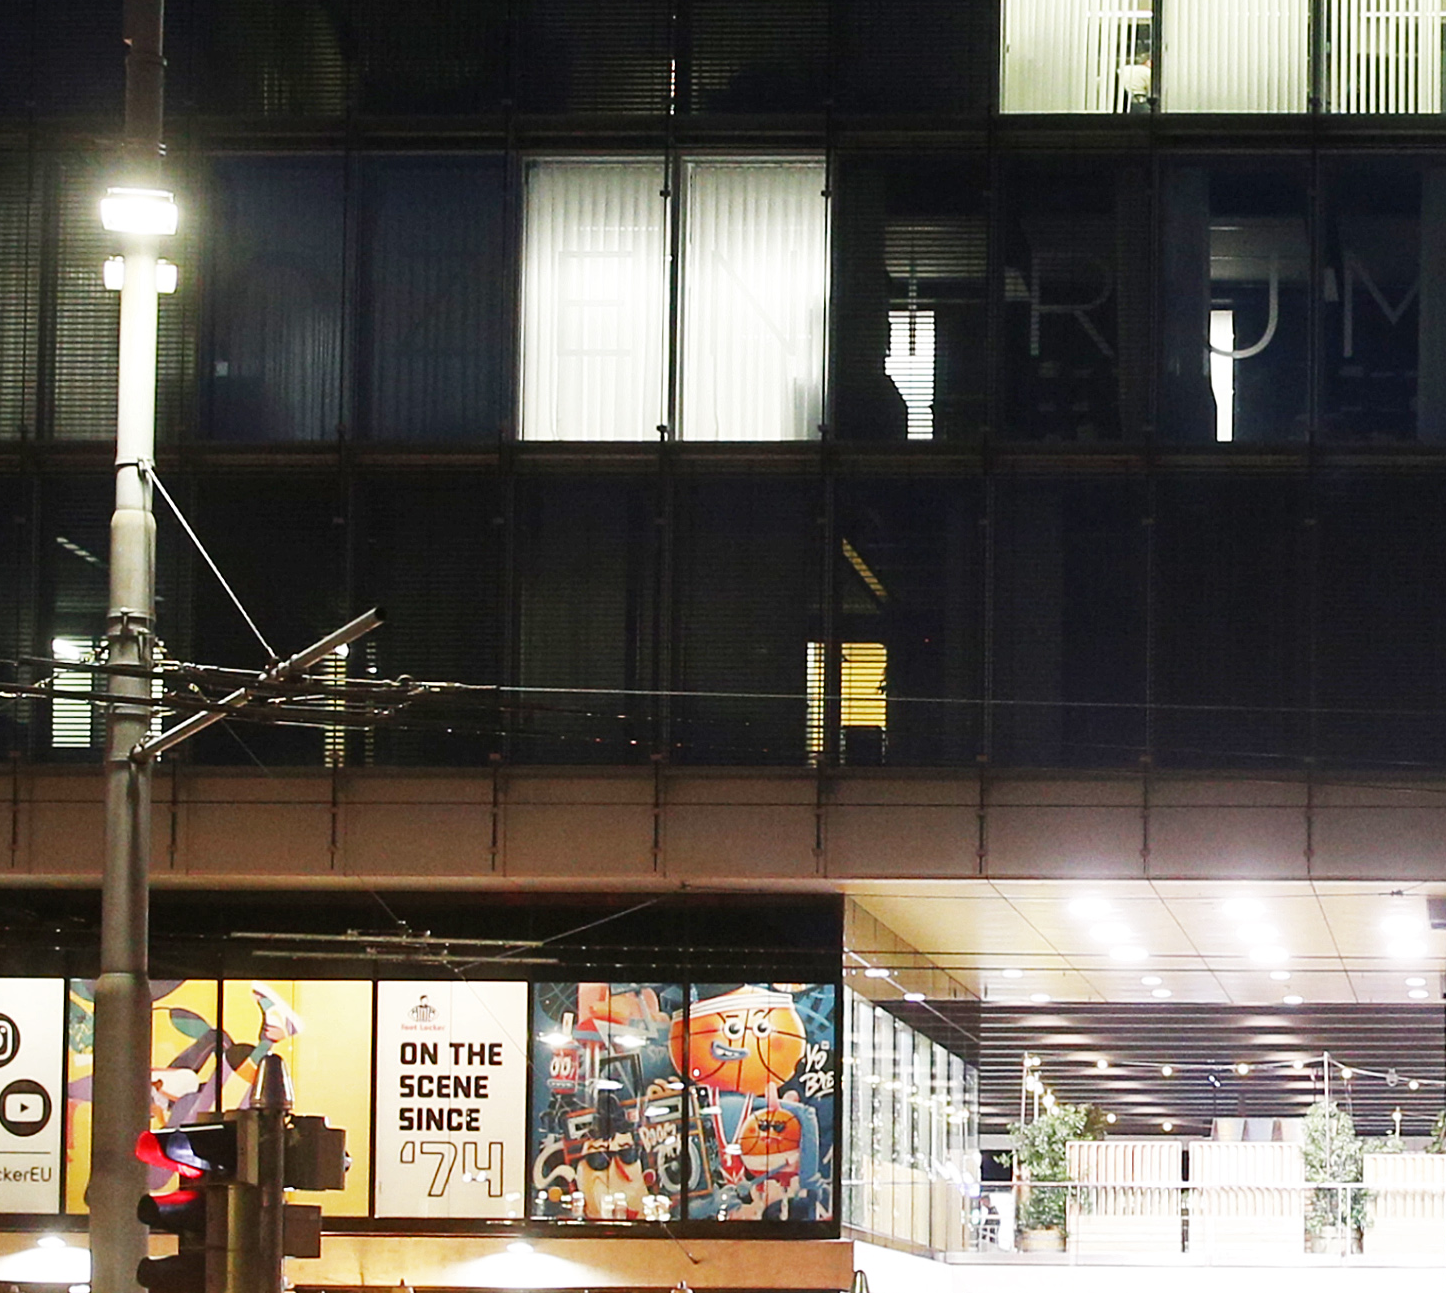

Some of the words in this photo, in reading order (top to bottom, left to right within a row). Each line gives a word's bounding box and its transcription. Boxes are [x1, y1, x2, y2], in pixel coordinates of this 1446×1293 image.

[400, 1042, 438, 1065] ON
[449, 1043, 503, 1066] THE
[399, 1075, 489, 1098] SCENE
[398, 1107, 481, 1133] SINCE
[400, 1141, 504, 1197] '74
